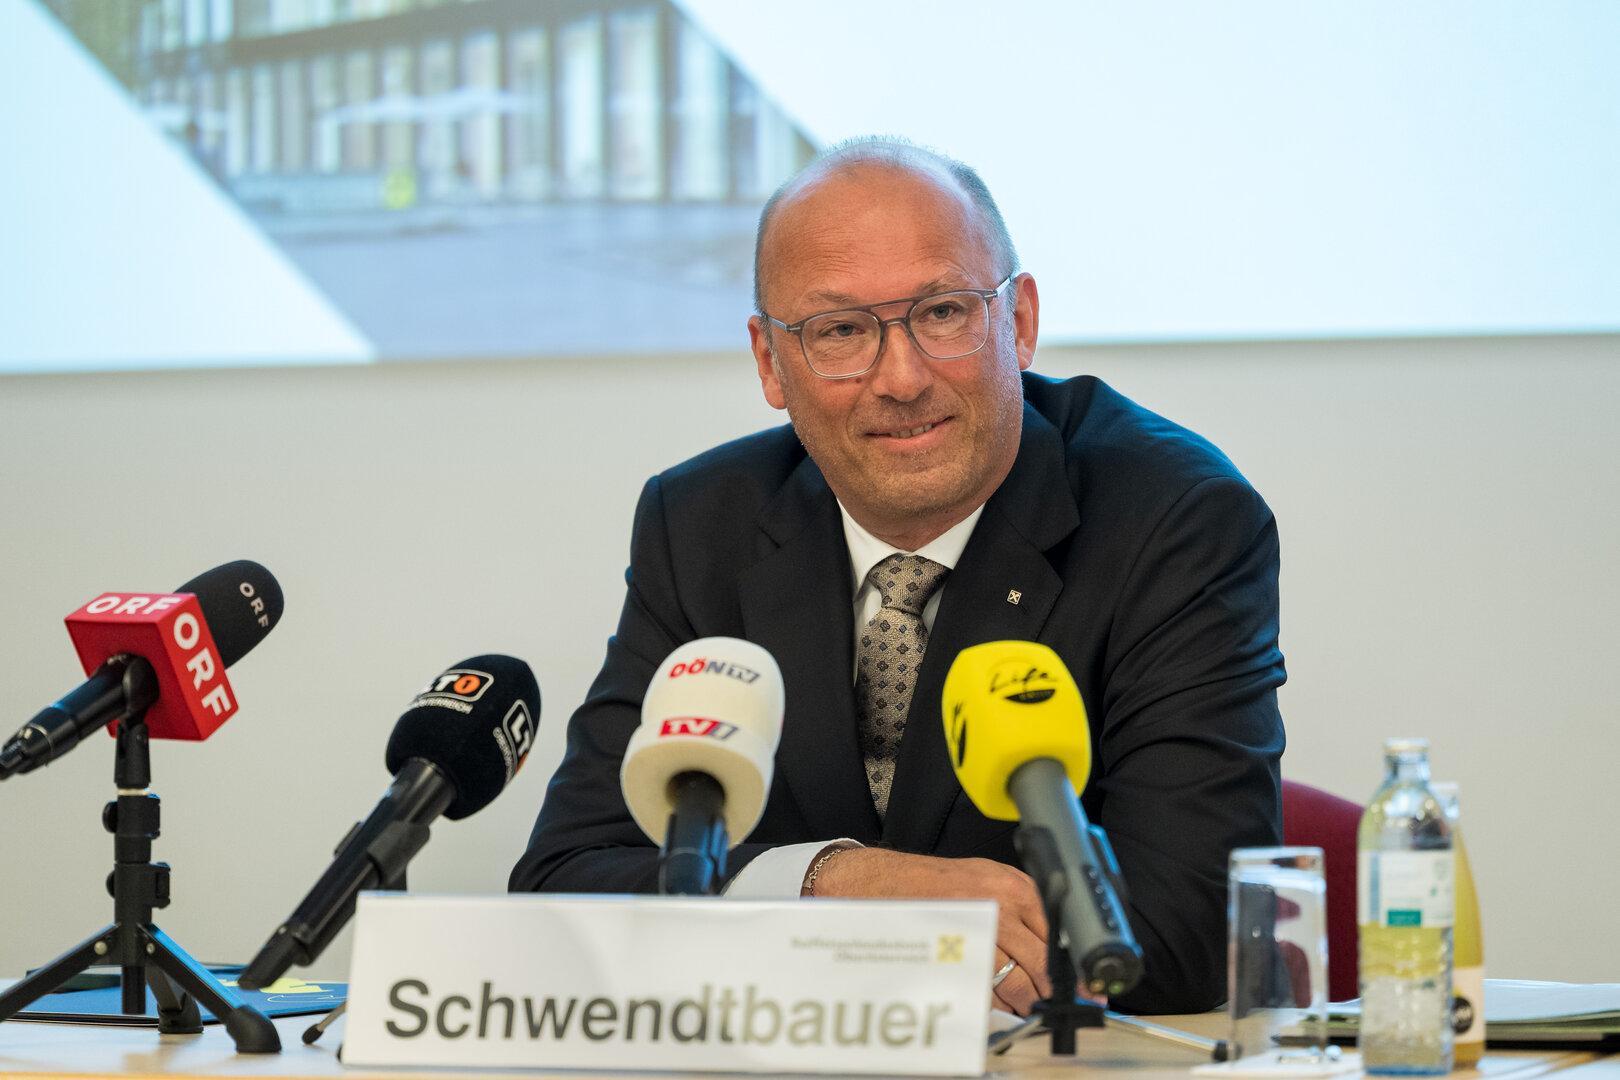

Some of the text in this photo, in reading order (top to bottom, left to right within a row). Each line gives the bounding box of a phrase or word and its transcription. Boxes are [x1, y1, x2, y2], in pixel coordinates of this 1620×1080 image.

[86, 596, 182, 615] ORF
[239, 582, 269, 628] ORF
[173, 612, 233, 717] ORF
[385, 978, 951, 1048] Schwendtbauer
